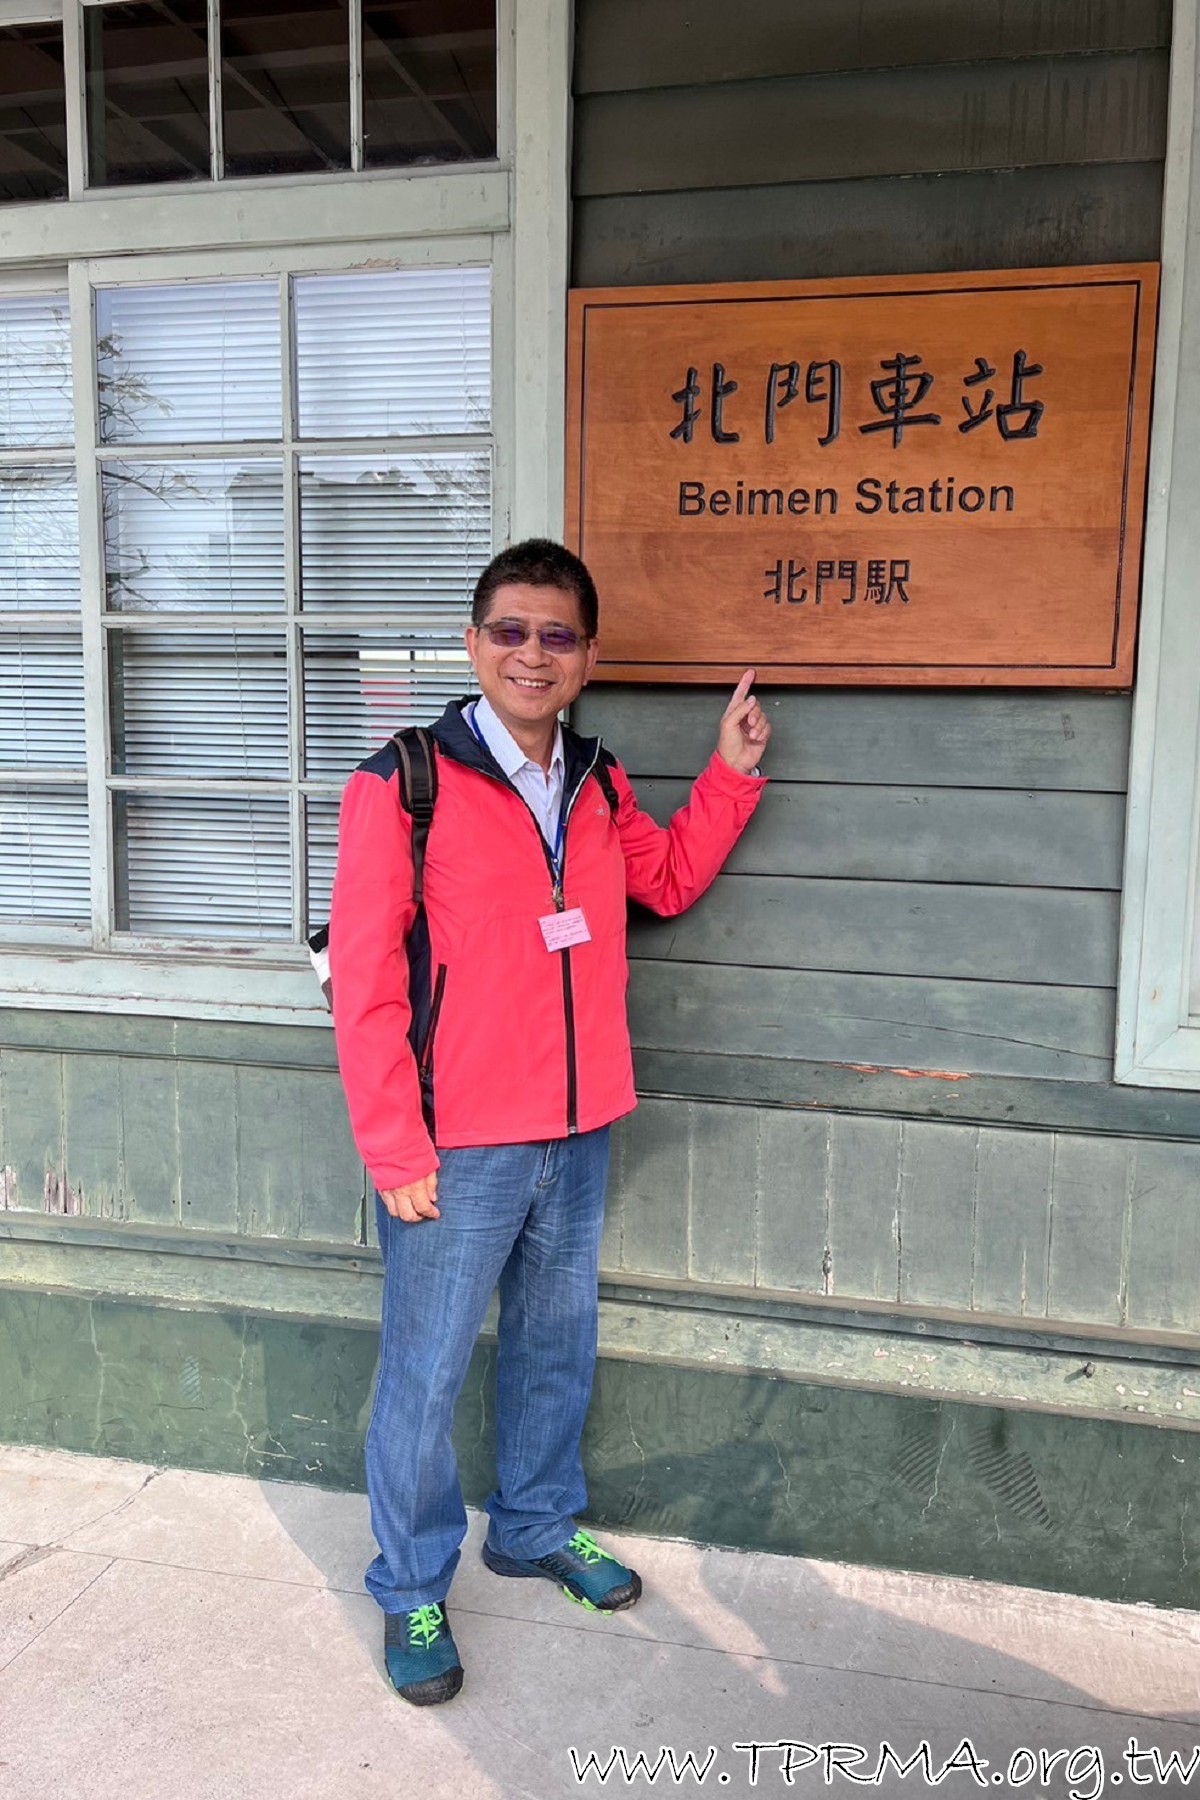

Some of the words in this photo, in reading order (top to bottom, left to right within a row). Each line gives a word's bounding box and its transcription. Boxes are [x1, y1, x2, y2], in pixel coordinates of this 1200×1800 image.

[669, 349, 1045, 448] 北門車站
[679, 480, 838, 517] Beimen
[855, 476, 1015, 514] Station
[763, 559, 911, 605] 北門駅
